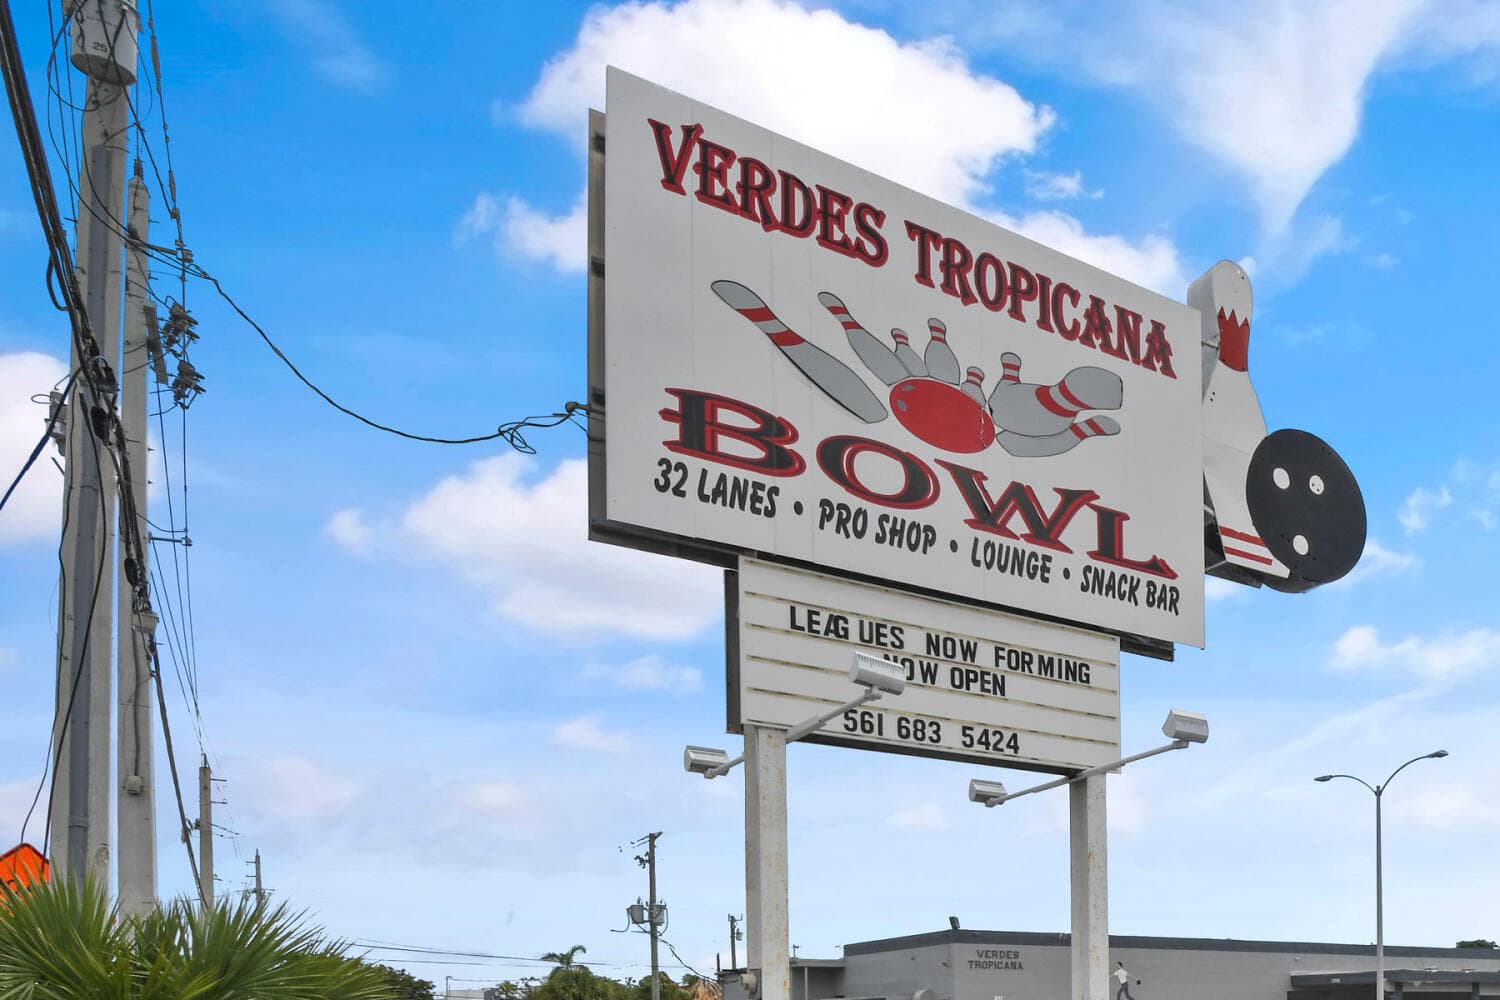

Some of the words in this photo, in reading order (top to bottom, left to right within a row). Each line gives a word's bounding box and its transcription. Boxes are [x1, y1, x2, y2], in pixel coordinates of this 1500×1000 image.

[647, 118, 888, 267] VERDES
[904, 220, 1177, 379] TROPICANA
[658, 387, 1178, 579] BOWL
[654, 458, 688, 498] 32
[697, 468, 779, 518] LANES
[819, 499, 868, 539] PRO
[875, 514, 936, 554] SHOP
[971, 537, 1052, 583] LOUNGE
[1080, 564, 1141, 606] SNACK
[1146, 580, 1180, 616] BAR
[926, 632, 978, 663] NOW
[994, 645, 1091, 685] FORMING
[950, 667, 1006, 696] OPEN
[844, 709, 883, 736] 561
[897, 716, 941, 743] 683
[961, 726, 1020, 754] 5424
[968, 960, 1023, 970] TROPICANA
[976, 950, 1020, 960] VERDES
